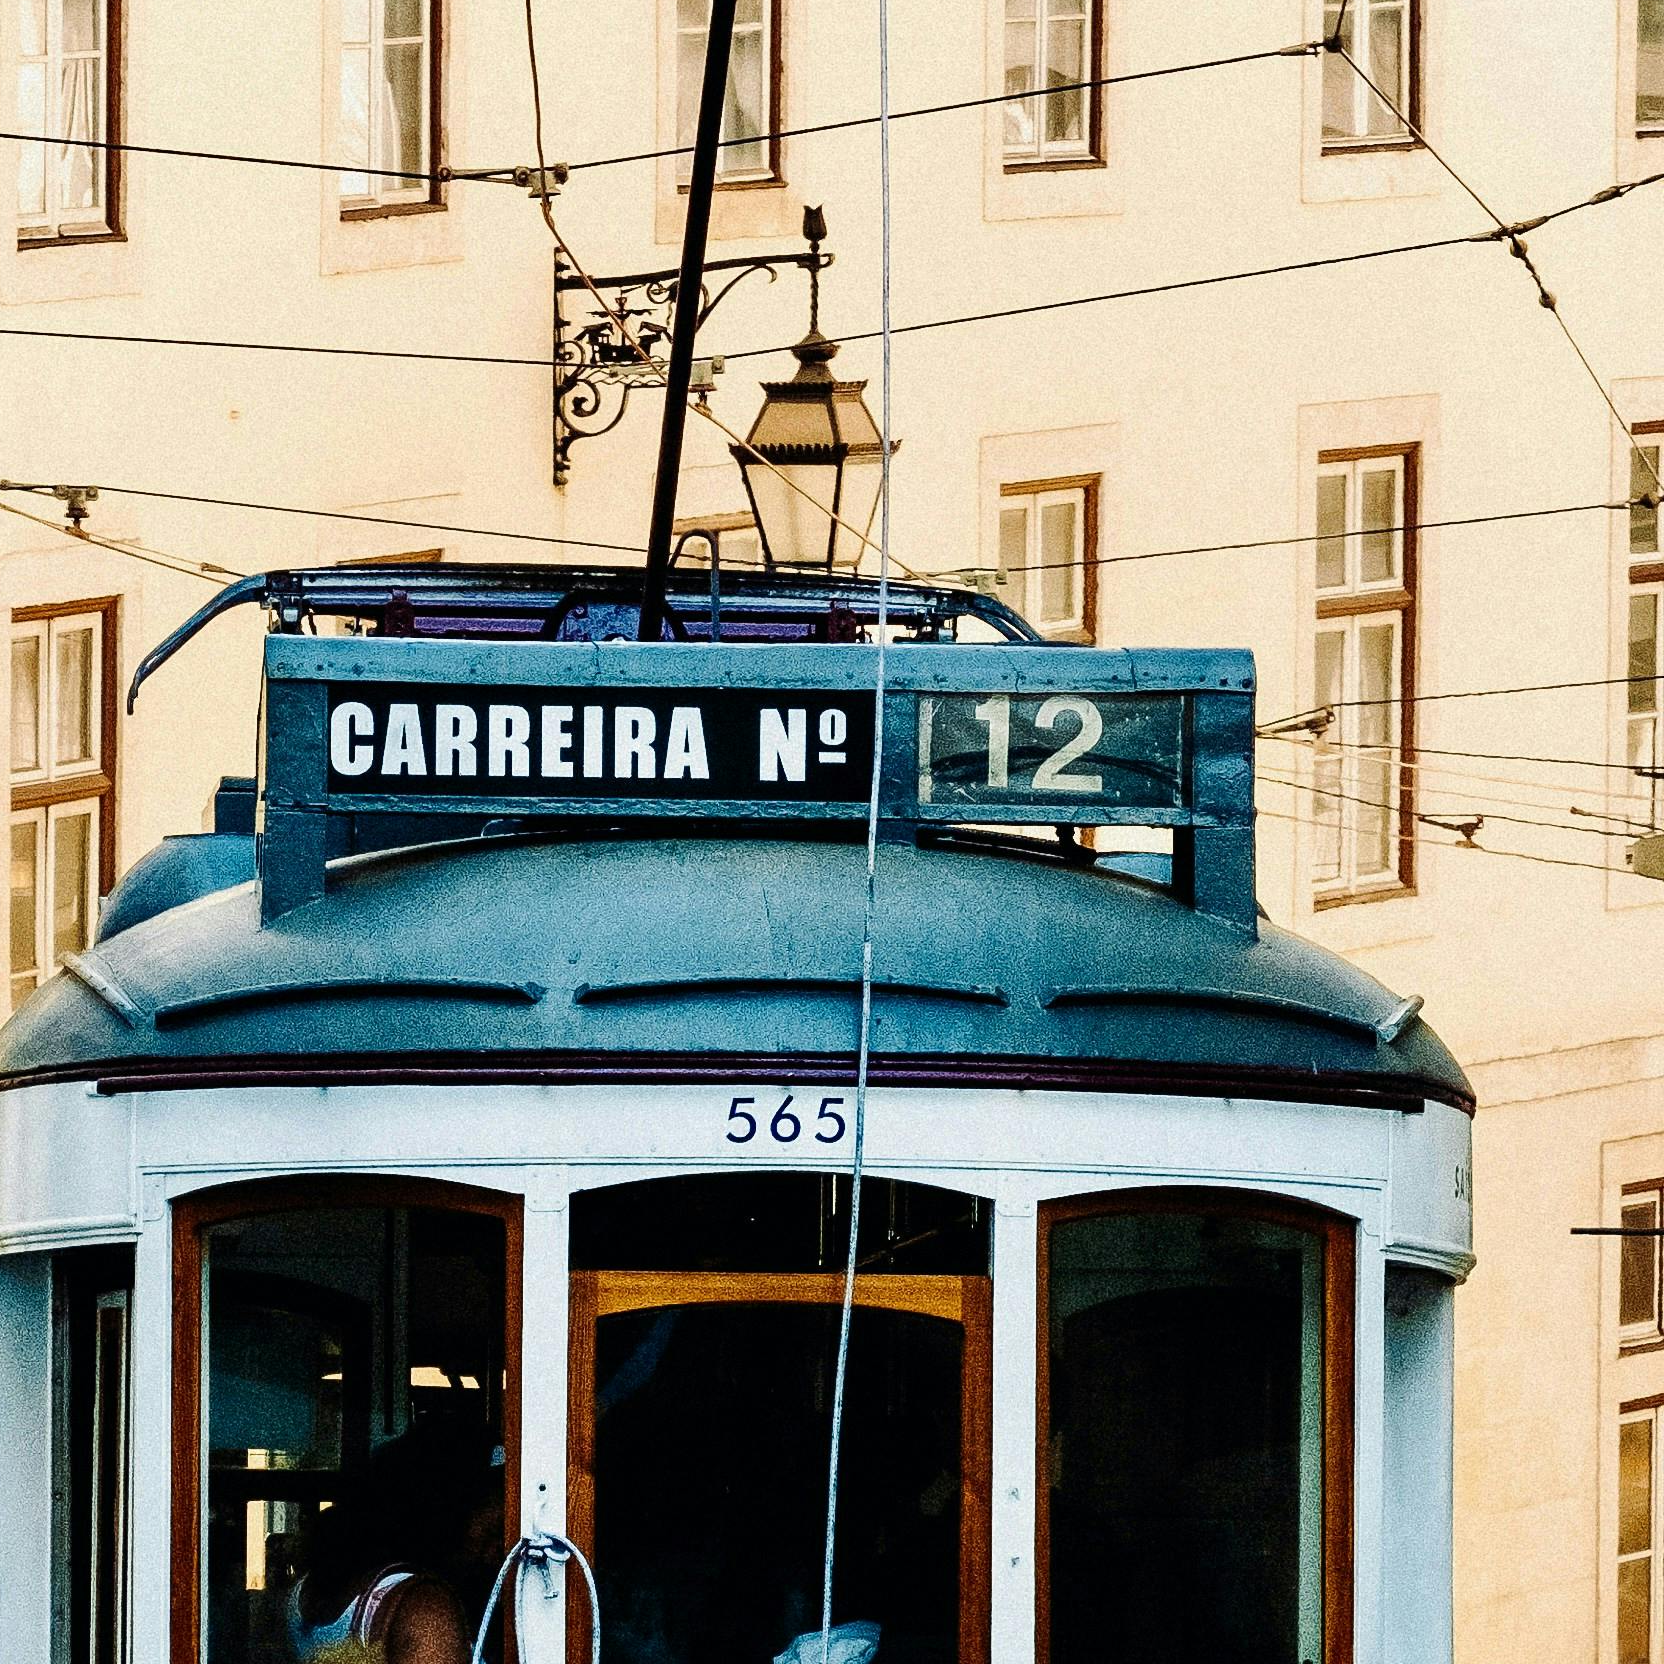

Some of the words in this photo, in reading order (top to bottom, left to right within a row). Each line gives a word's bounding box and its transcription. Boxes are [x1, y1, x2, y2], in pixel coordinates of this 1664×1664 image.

[330, 701, 710, 780] CARREIRA
[759, 708, 847, 782] Nº
[974, 694, 1103, 793] 12
[725, 1094, 846, 1144] 565
